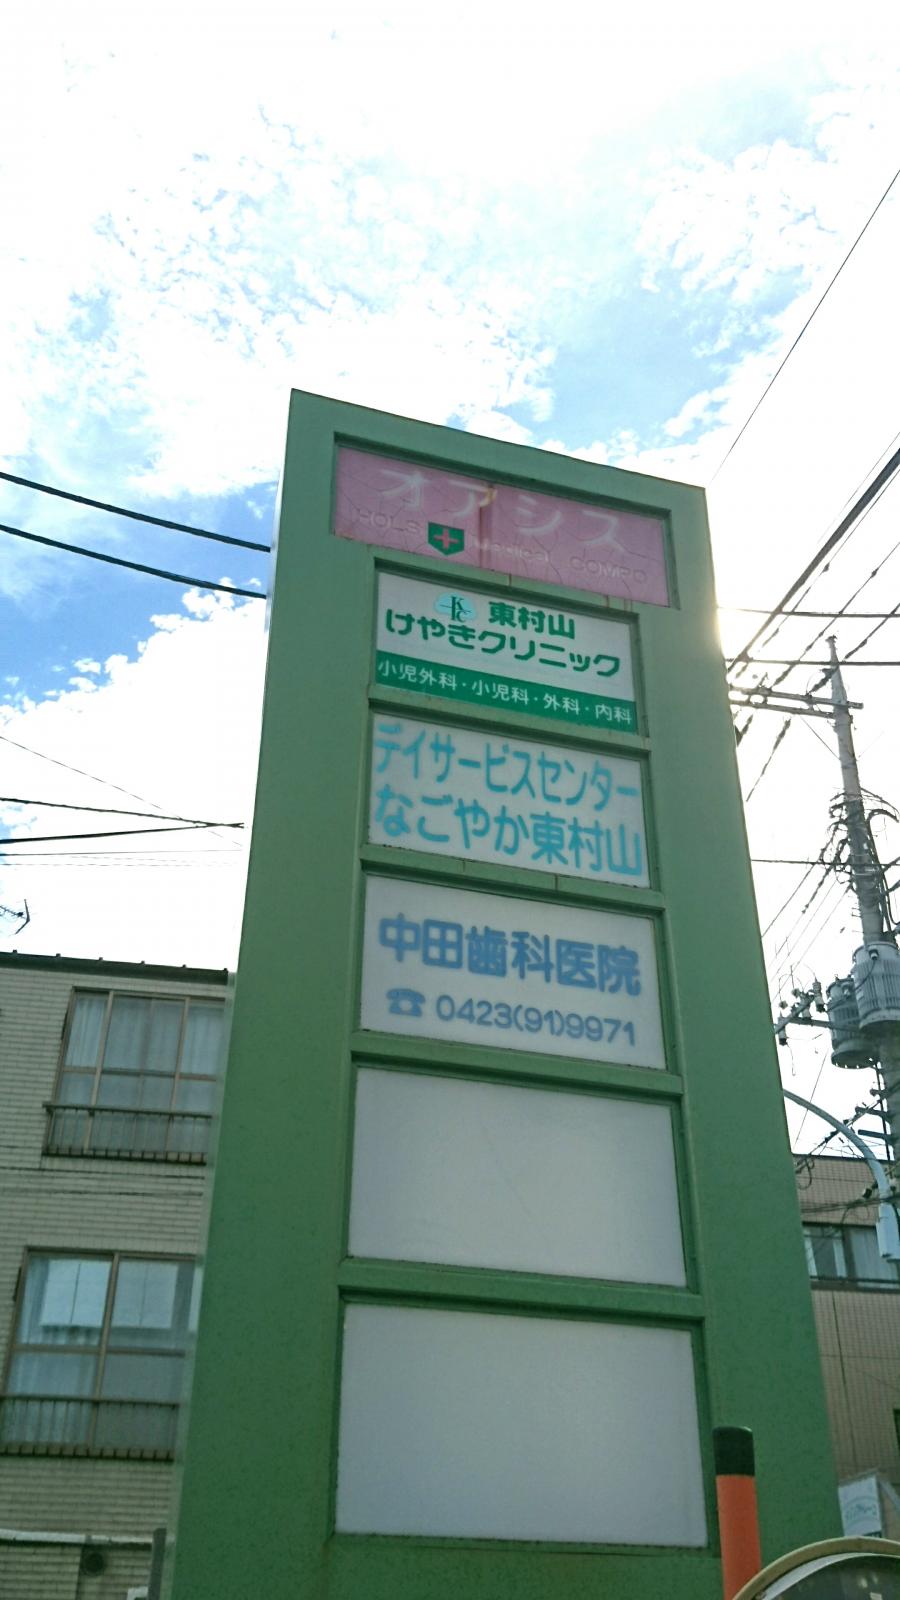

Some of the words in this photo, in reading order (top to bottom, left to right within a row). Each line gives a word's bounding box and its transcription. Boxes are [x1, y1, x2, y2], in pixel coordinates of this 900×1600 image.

[386, 609, 620, 677] けやきクリニック
[488, 601, 575, 640] 東村山
[375, 784, 643, 876] なごやか東村山
[379, 912, 641, 996] 中田歯科医院
[435, 994, 636, 1047] 0423(91)9971
